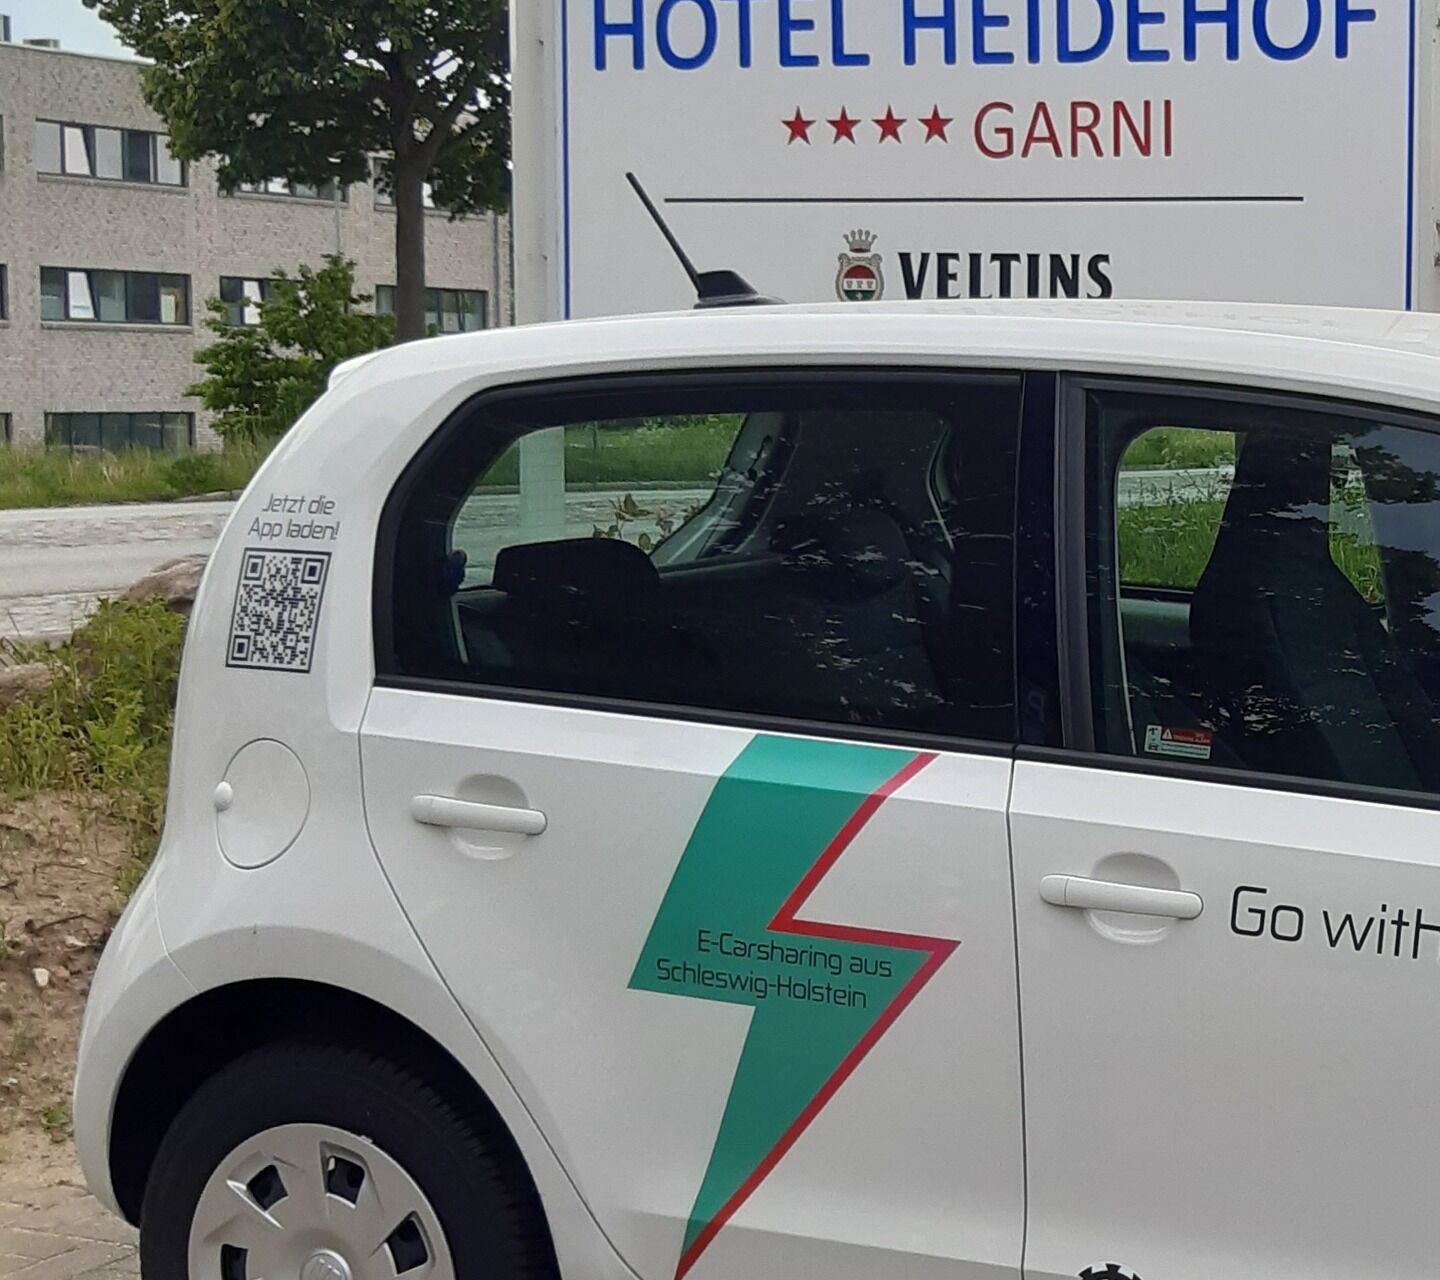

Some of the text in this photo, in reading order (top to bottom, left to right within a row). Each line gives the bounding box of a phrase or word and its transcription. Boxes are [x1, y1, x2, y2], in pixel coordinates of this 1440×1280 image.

[973, 99, 1174, 160] GARNI
[897, 252, 1113, 299] VELTINS
[248, 516, 341, 541] App laden!
[262, 493, 335, 515] Jetzt die
[1230, 884, 1304, 942] Go
[697, 929, 893, 978] E-Carsharing aus
[656, 958, 867, 1009] Schleswig-Holstein
